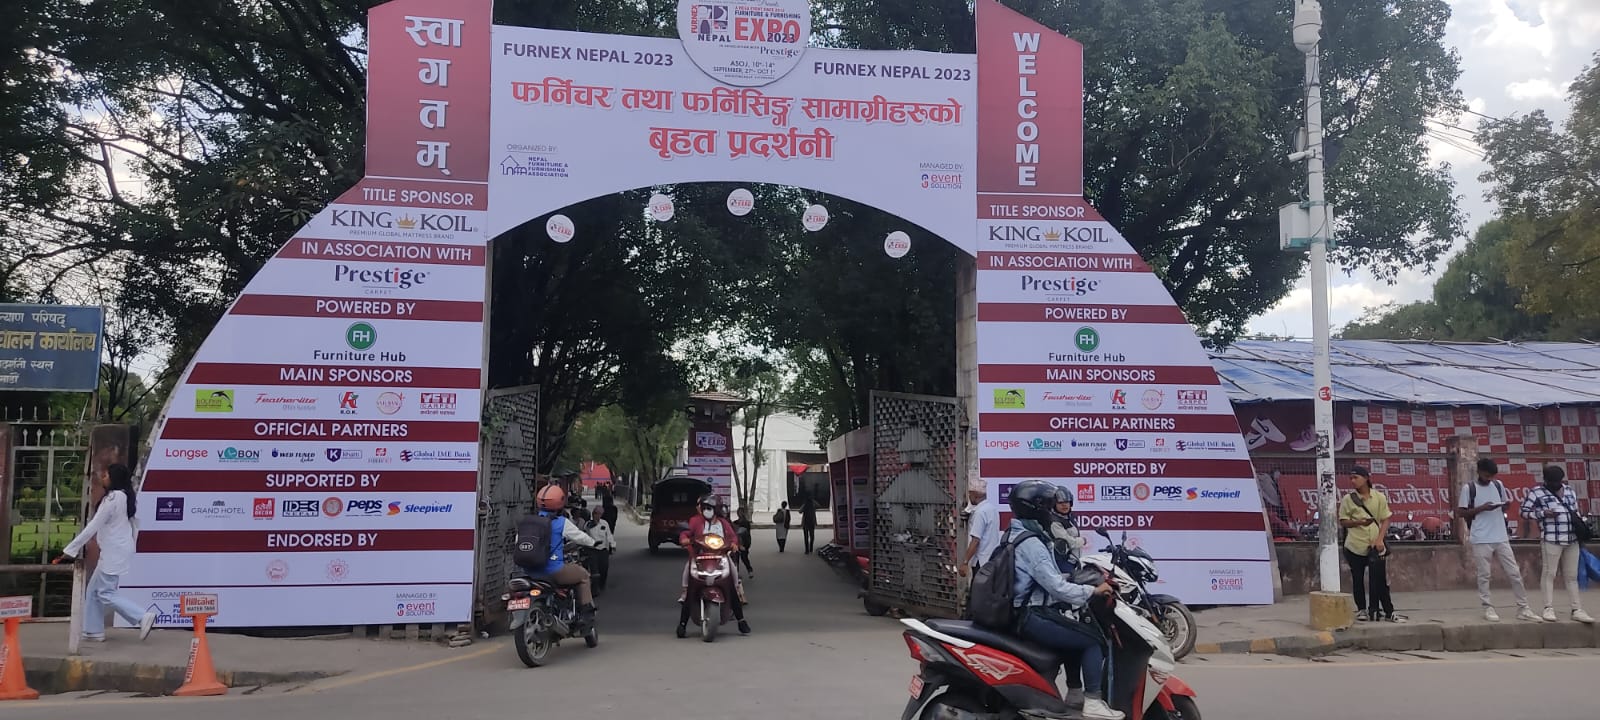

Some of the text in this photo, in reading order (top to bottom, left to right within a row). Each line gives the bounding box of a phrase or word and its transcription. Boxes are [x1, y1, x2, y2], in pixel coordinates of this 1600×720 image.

[735, 18, 801, 43] EXPO
[698, 34, 731, 43] NEPAL
[768, 33, 795, 43] 2023
[503, 43, 674, 66] FURNEX NEPAL 2023
[760, 46, 799, 58] Prestige
[814, 62, 971, 81] FURNEX NEPAL 2023
[511, 77, 614, 108] फर्निचर
[621, 88, 674, 111] तथा
[1012, 32, 1041, 186] WELCOME
[507, 144, 547, 152] ORGANIZED
[649, 127, 835, 159] बृहत प्रदर्शनी
[930, 173, 962, 183] event
[363, 188, 474, 205] TITLE SPONSOR
[990, 205, 1085, 218] TITLE SPONSOR
[331, 210, 393, 229] KING
[989, 225, 1040, 241] KING
[302, 242, 472, 261] IN ASSOCIATION WITH
[990, 255, 1133, 269] IN ASSOCIATION WITH
[335, 264, 426, 289] Prestige
[1021, 275, 1098, 296] Prestige
[316, 299, 416, 315] POWERED BY
[1045, 307, 1128, 320] POWERED BY
[39, 328, 97, 352] कार्यालय
[352, 330, 370, 342] FH
[1079, 334, 1094, 345] FH
[314, 350, 406, 362] Furniture Hub
[1048, 352, 1126, 362] Furniture Hub
[280, 367, 413, 383] MAIN SPONSORS
[1046, 369, 1156, 382] MAIN SPONSORS
[423, 393, 455, 404] YETI
[1179, 390, 1207, 400] YETI
[254, 422, 408, 437] OFFICIAL PARTNERS
[1050, 417, 1176, 430] OFFICIAL PARTNERS
[985, 439, 1020, 450] Longse
[1118, 440, 1126, 449] K
[166, 448, 208, 460] Longse
[330, 449, 338, 460] K
[413, 450, 435, 458] Global
[1073, 462, 1167, 475] SUPPORTED BY
[266, 474, 380, 488] SUPPORTED BY
[1201, 490, 1240, 499] Sleepwell
[403, 503, 453, 514] Sleepwell
[1074, 515, 1154, 528] NDORSED BY
[267, 533, 378, 548] ENDORSED BY
[406, 601, 435, 611] event
